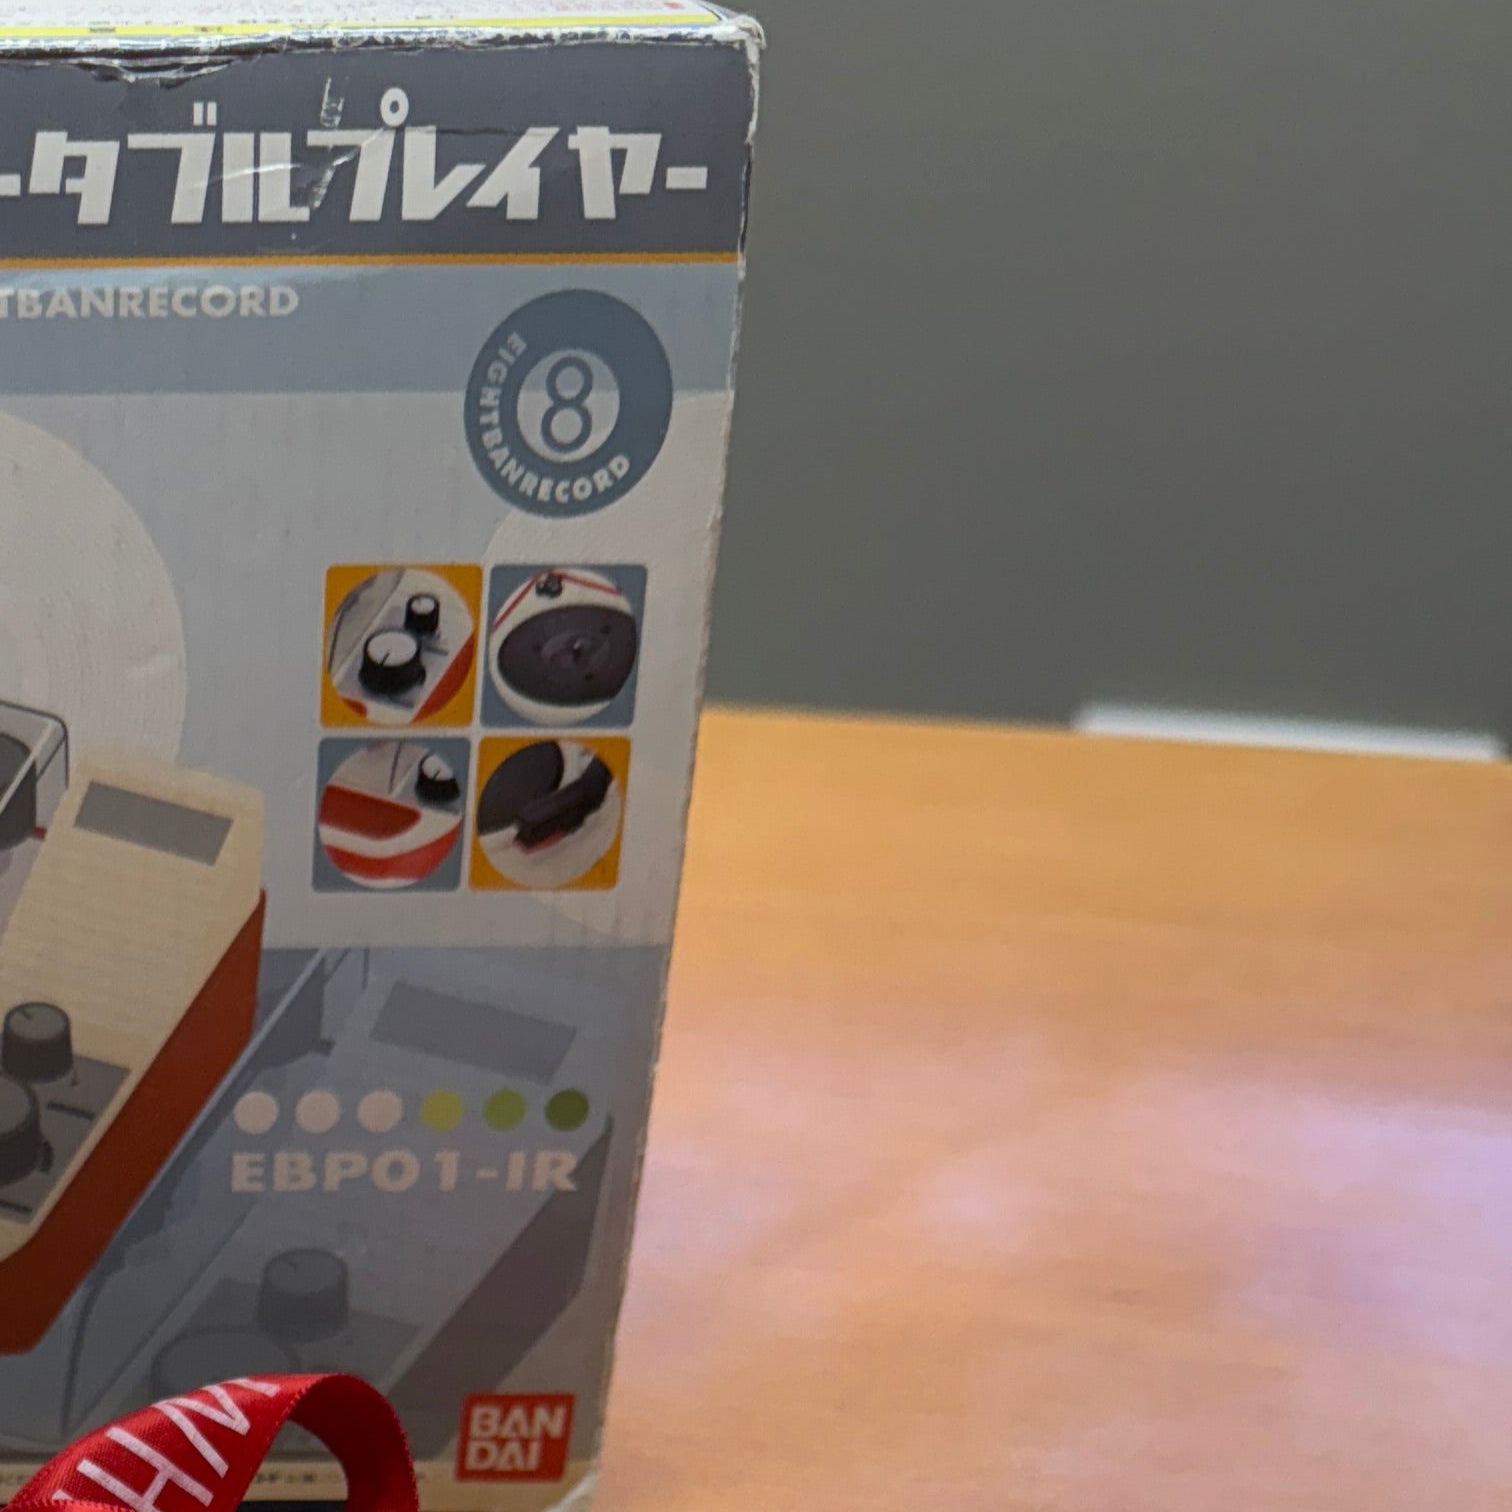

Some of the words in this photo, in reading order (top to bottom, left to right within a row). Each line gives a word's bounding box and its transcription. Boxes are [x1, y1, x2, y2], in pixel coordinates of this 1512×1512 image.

[479, 331, 631, 503] EIGHTBANRECORD
[469, 1404, 567, 1438] BAN
[464, 1440, 542, 1471] DAI
